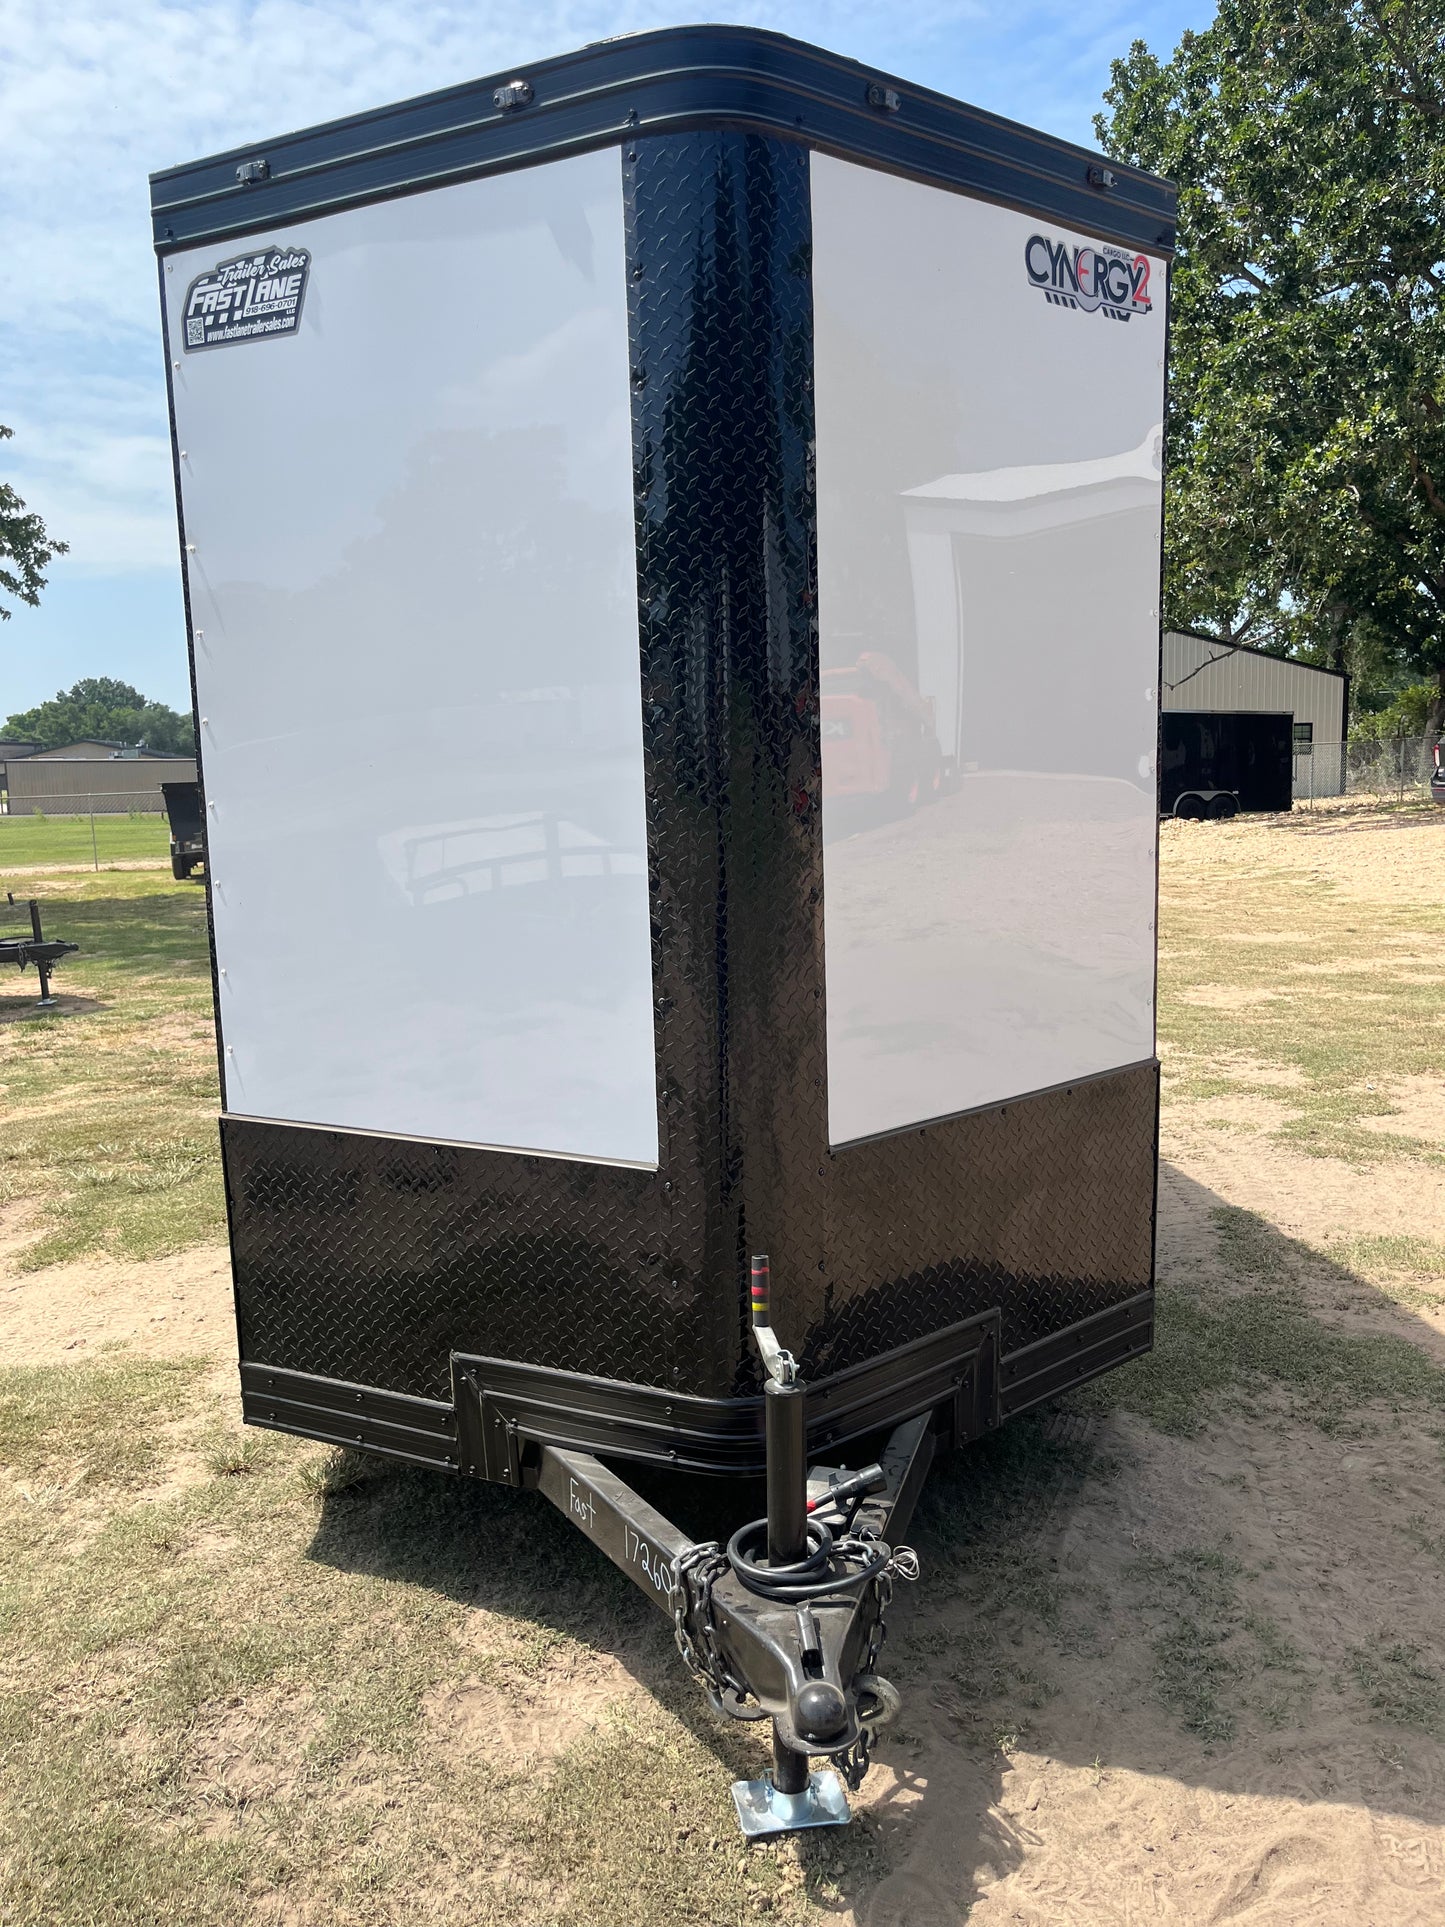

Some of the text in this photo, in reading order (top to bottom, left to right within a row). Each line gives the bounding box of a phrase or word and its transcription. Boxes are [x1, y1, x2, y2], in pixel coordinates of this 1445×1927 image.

[220, 254, 306, 285] Trailer Sales
[245, 299, 296, 315] 918-696-0701
[207, 316, 295, 342] www.fastlanetrailersales.com
[569, 1477, 597, 1529] Fast
